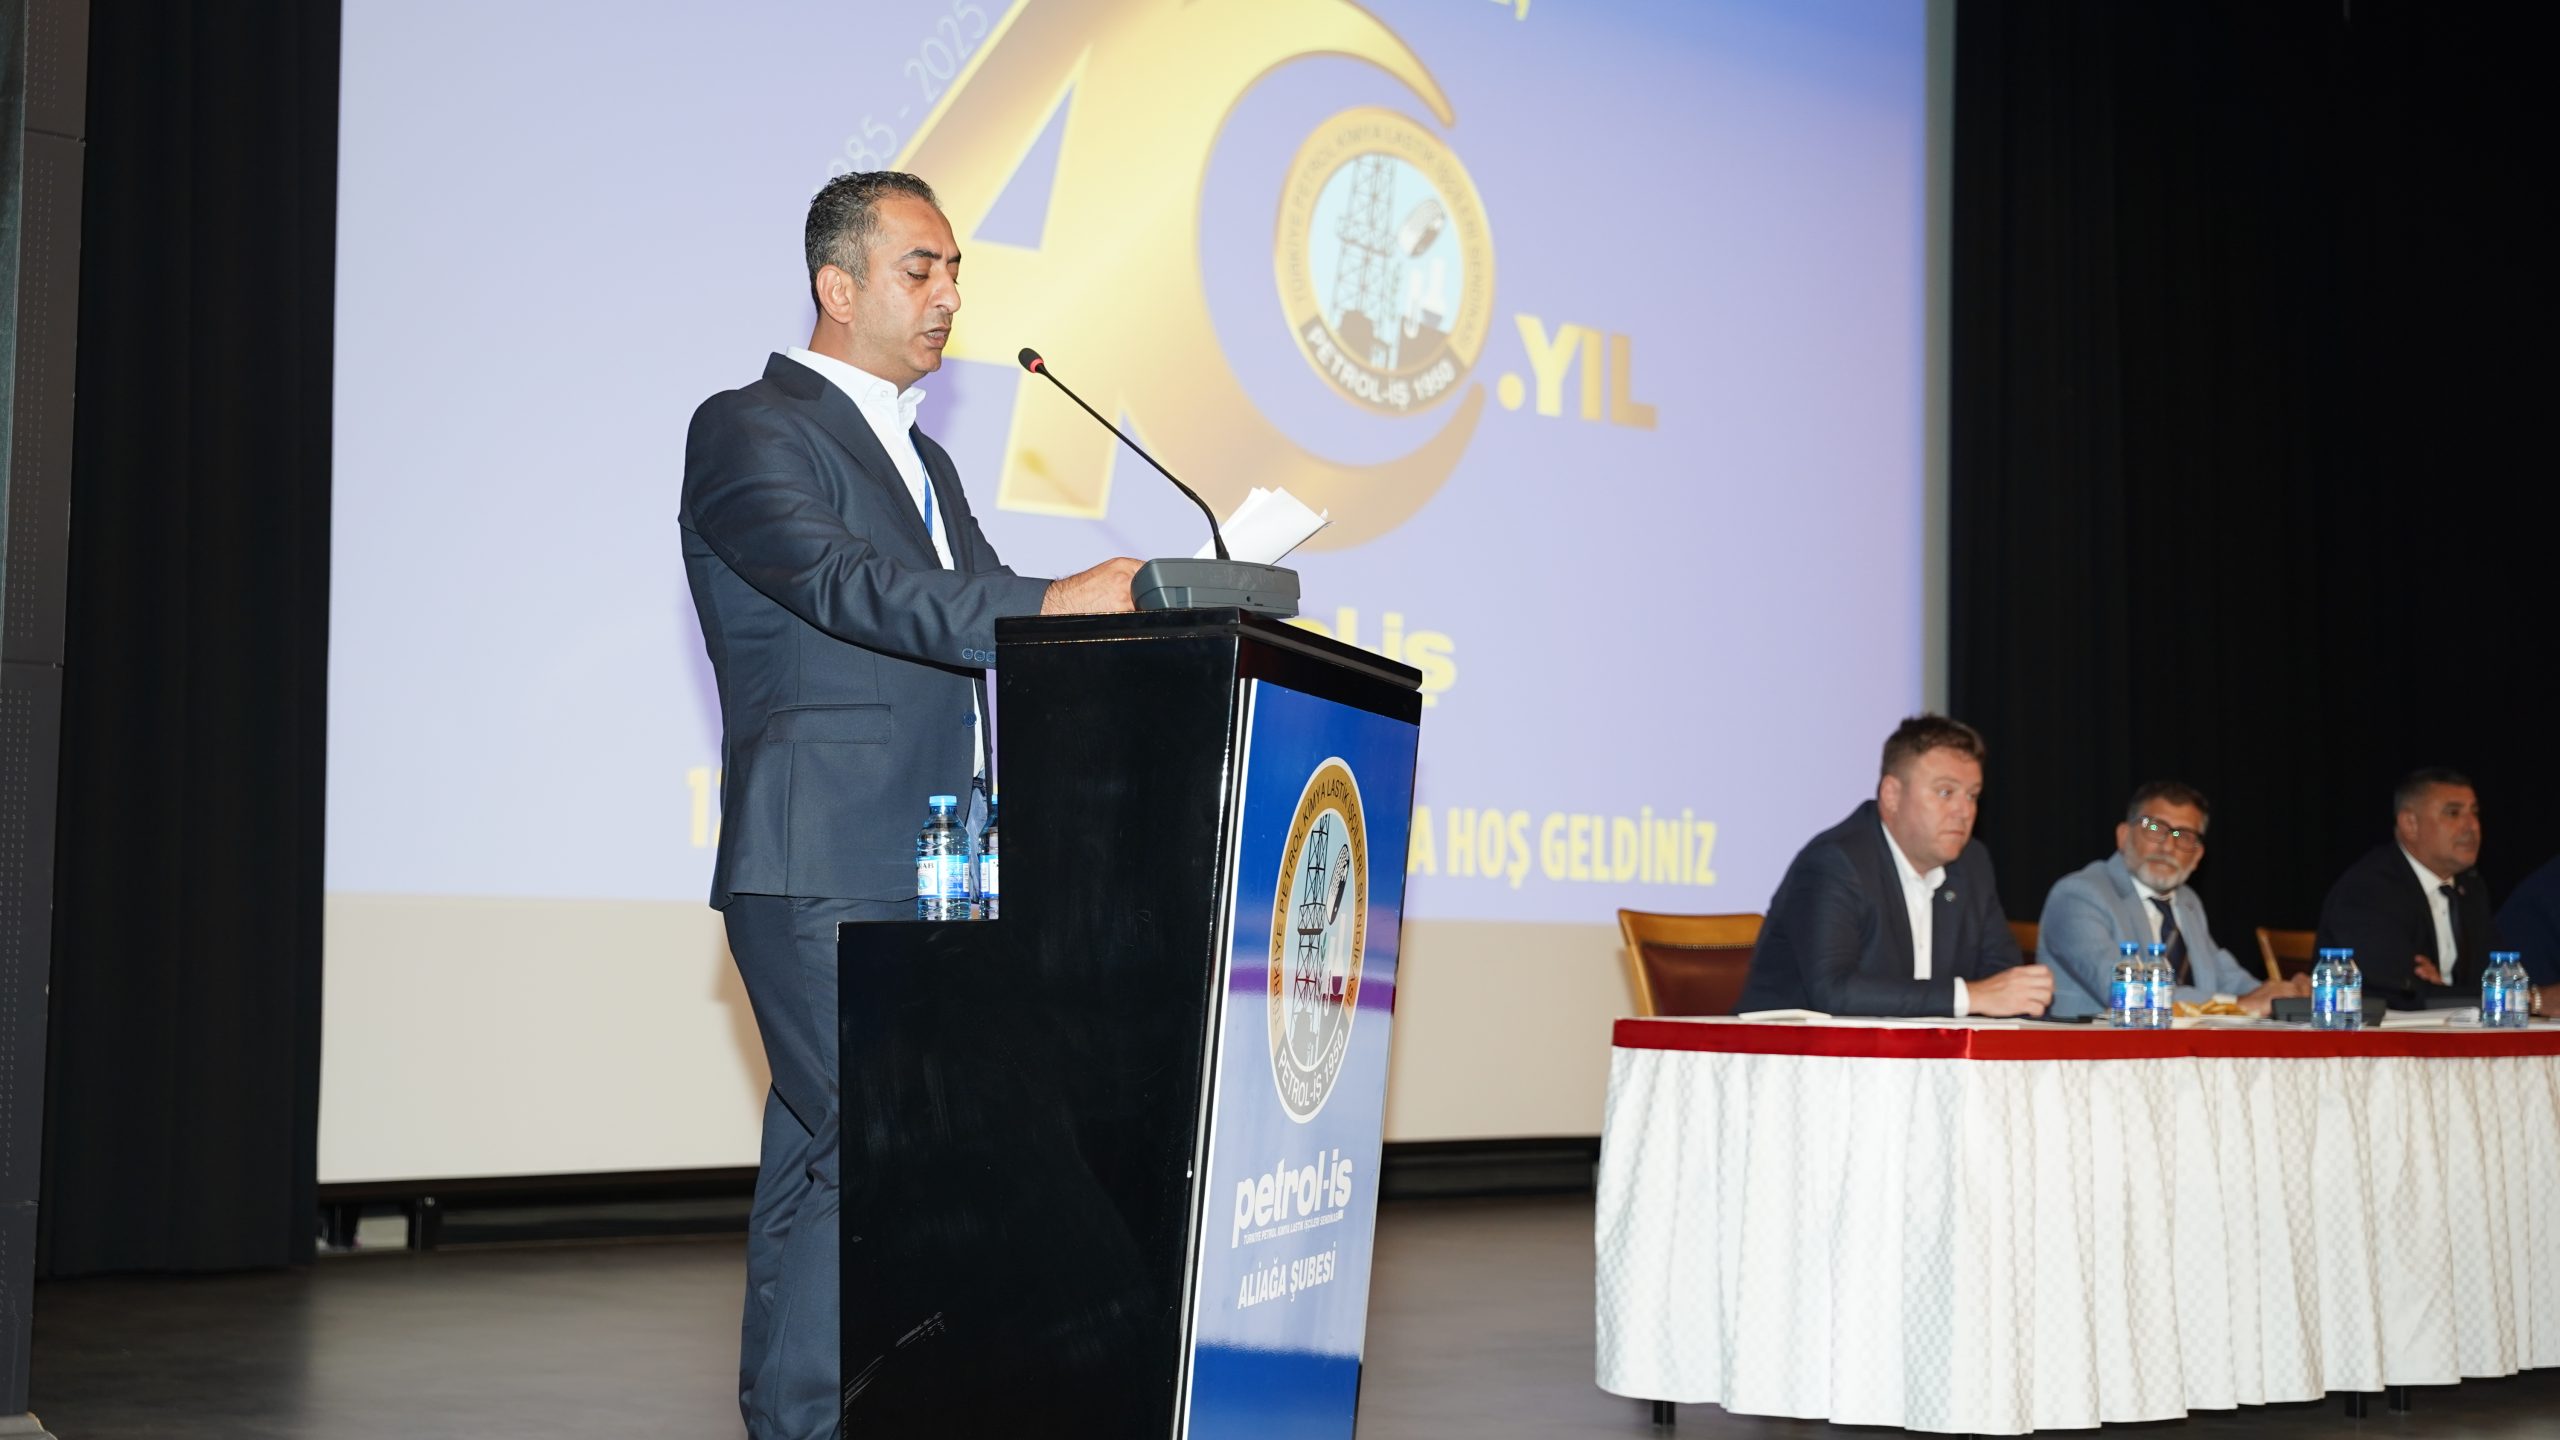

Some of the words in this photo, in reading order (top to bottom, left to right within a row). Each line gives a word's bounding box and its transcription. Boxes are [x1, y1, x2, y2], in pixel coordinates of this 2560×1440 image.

[904, 0, 989, 104] 2025
[1447, 806, 1531, 890] HOŞ
[1540, 804, 1718, 886] GELDİNİZ
[1275, 921, 1283, 1031] TÜRKİYE
[1280, 830, 1304, 914] PETROL
[1303, 784, 1326, 826] KİMYA
[1326, 779, 1350, 809] LASTİK
[1278, 1047, 1323, 1106] PETROL-İŞ
[1323, 1029, 1345, 1084] 1950
[1237, 1256, 1287, 1310] ALİAĞA
[1289, 1241, 1337, 1302] ŞUBESİ
